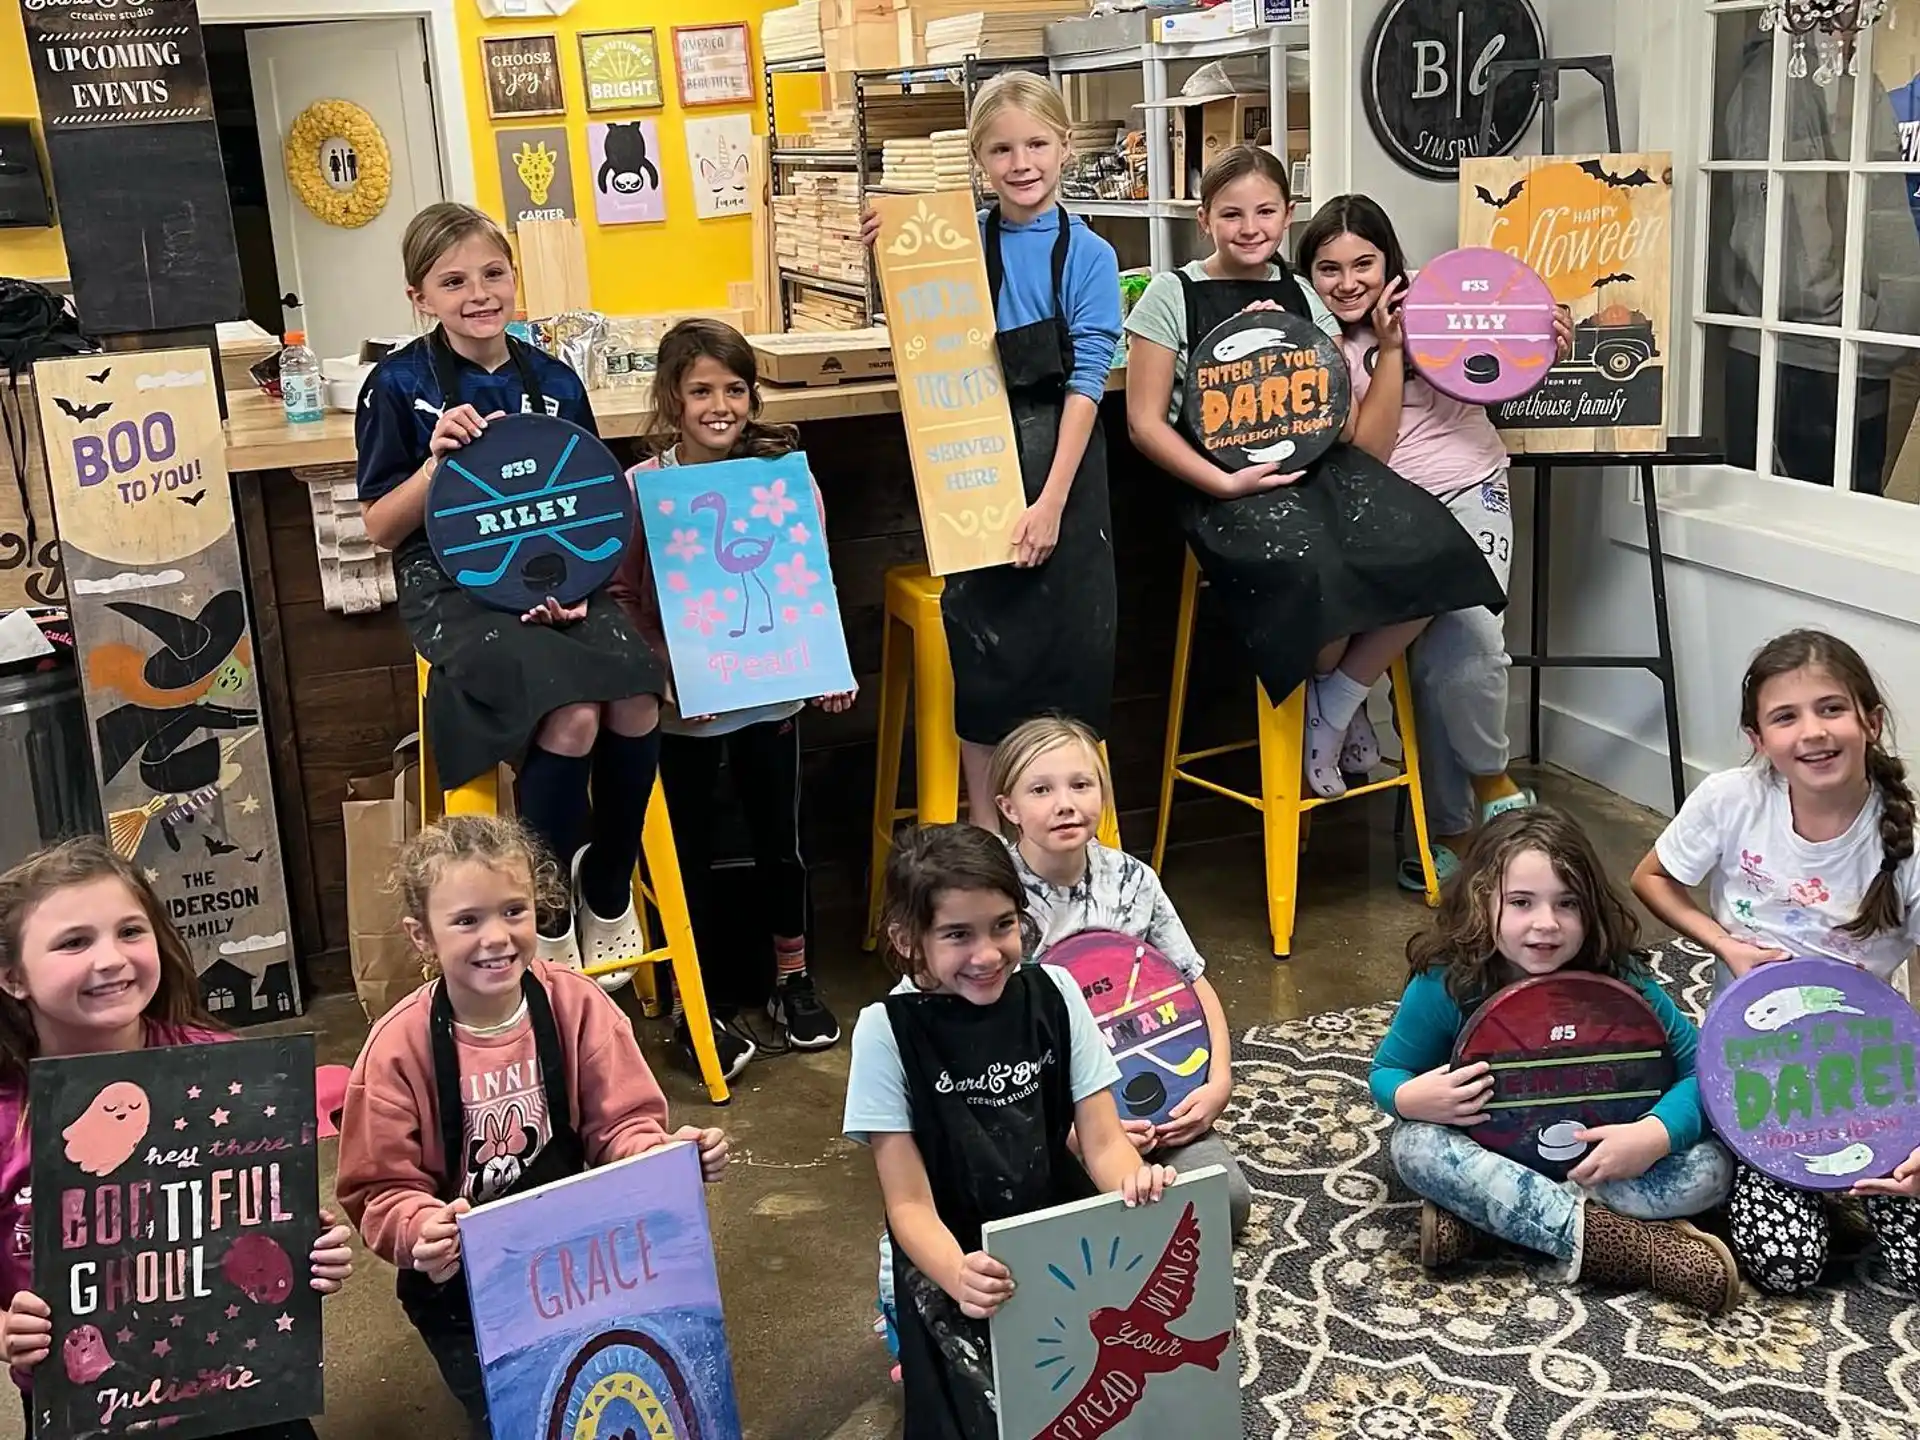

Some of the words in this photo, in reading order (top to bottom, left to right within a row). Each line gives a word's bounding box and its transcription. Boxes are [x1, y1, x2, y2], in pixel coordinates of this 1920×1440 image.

[70, 11, 116, 21] creative
[119, 8, 155, 20] studio
[46, 41, 181, 72] UPCOMING
[491, 51, 552, 68] CHOOSE
[71, 79, 170, 109] EVENTS
[504, 67, 543, 97] joy
[591, 79, 656, 99] BRIGHT
[1413, 122, 1501, 161] SIMSBUY
[518, 208, 566, 221] CARTER
[1572, 205, 1619, 224] HAPPY
[1446, 313, 1507, 330] LILY
[1197, 360, 1254, 389] ENTER
[1258, 355, 1278, 375] IF
[1282, 349, 1319, 369] YOU
[1201, 367, 1330, 434] DARE!
[1570, 388, 1628, 422] family
[72, 411, 176, 487] BOO
[926, 435, 1006, 463] SERVED
[117, 480, 147, 504] TO
[150, 459, 202, 495] YOU!
[501, 459, 537, 479] #39
[945, 466, 1000, 491] HERE
[475, 495, 578, 535] RILEY
[1477, 531, 1509, 562] 33
[707, 636, 811, 684] Pearl
[182, 871, 215, 888] THE
[177, 917, 234, 939] FAMILY
[1550, 1024, 1576, 1041] #5
[460, 1060, 543, 1102] INNI
[987, 1062, 1012, 1094] &
[1734, 1043, 1919, 1131] DARE!
[966, 1096, 1007, 1107] creative
[1006, 1081, 1040, 1103] studio
[144, 1146, 201, 1168] hey
[208, 1133, 293, 1158] there
[69, 1245, 212, 1317] GHOUL
[528, 1218, 660, 1320] GRACE
[1140, 1235, 1200, 1317] WINGS
[1103, 1321, 1183, 1357] your
[1053, 1369, 1138, 1440] SPREAD
